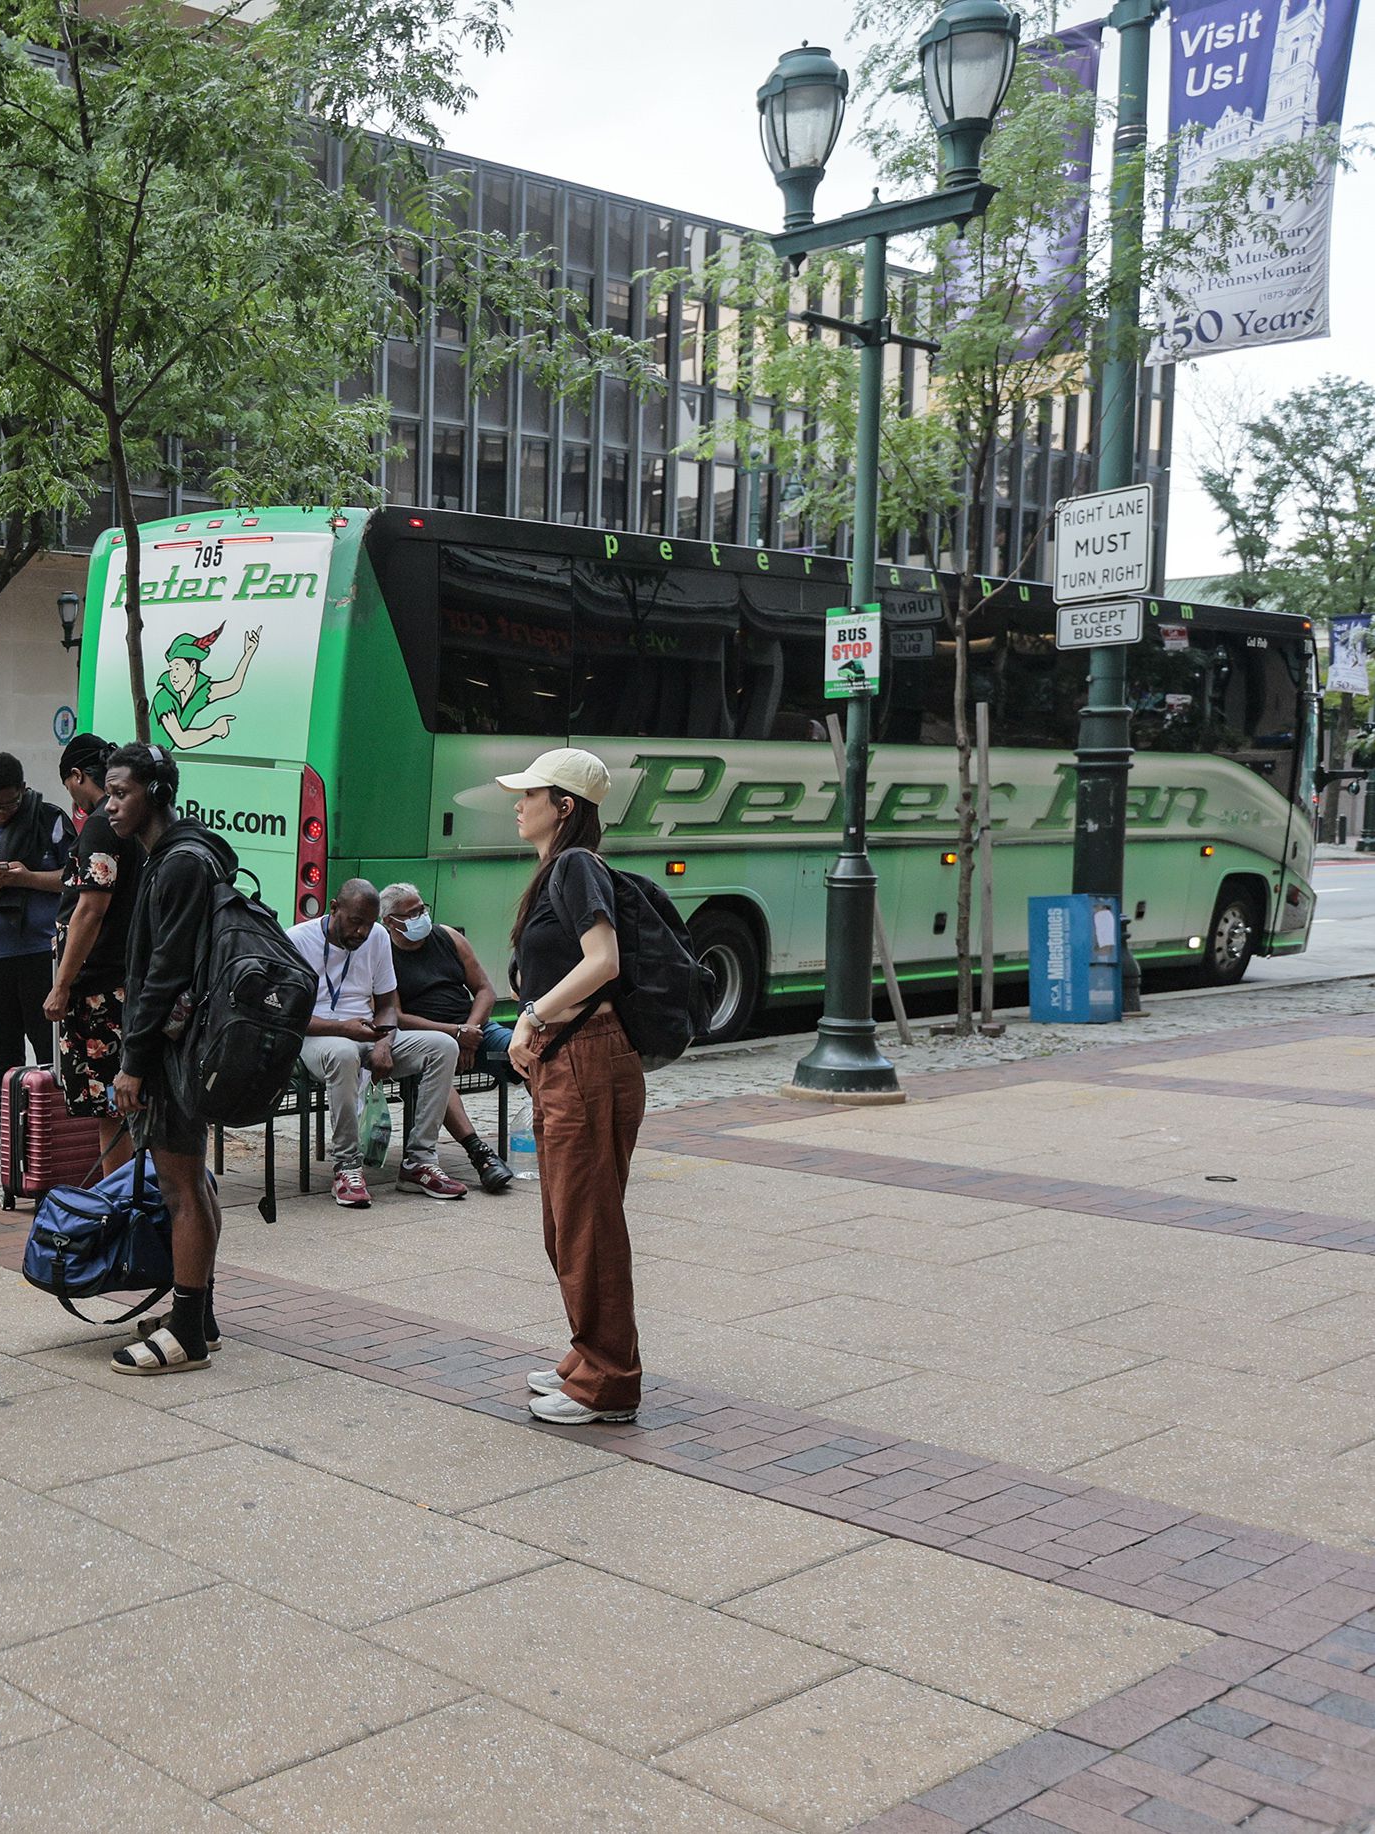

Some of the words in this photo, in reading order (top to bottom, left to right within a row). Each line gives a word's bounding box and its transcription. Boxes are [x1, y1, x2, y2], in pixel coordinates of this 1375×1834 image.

[1180, 9, 1263, 58] Visit
[1185, 52, 1248, 97] Us!
[1207, 261, 1312, 291] Pennsylvania
[1232, 307, 1316, 338] Years
[1063, 505, 1103, 527] RIGHT
[1108, 498, 1144, 519] LANE
[194, 545, 223, 568] 795
[1074, 531, 1132, 558] MUST
[232, 562, 319, 601] Pan
[1061, 570, 1096, 590] TURN
[1102, 563, 1143, 584] RIGHT
[1070, 608, 1127, 626] EXCEPT
[838, 627, 867, 642] BUS
[1073, 624, 1122, 640] BUSES
[832, 641, 873, 660] STOP
[601, 750, 1016, 837] Peter
[1047, 908, 1064, 980] Milestones
